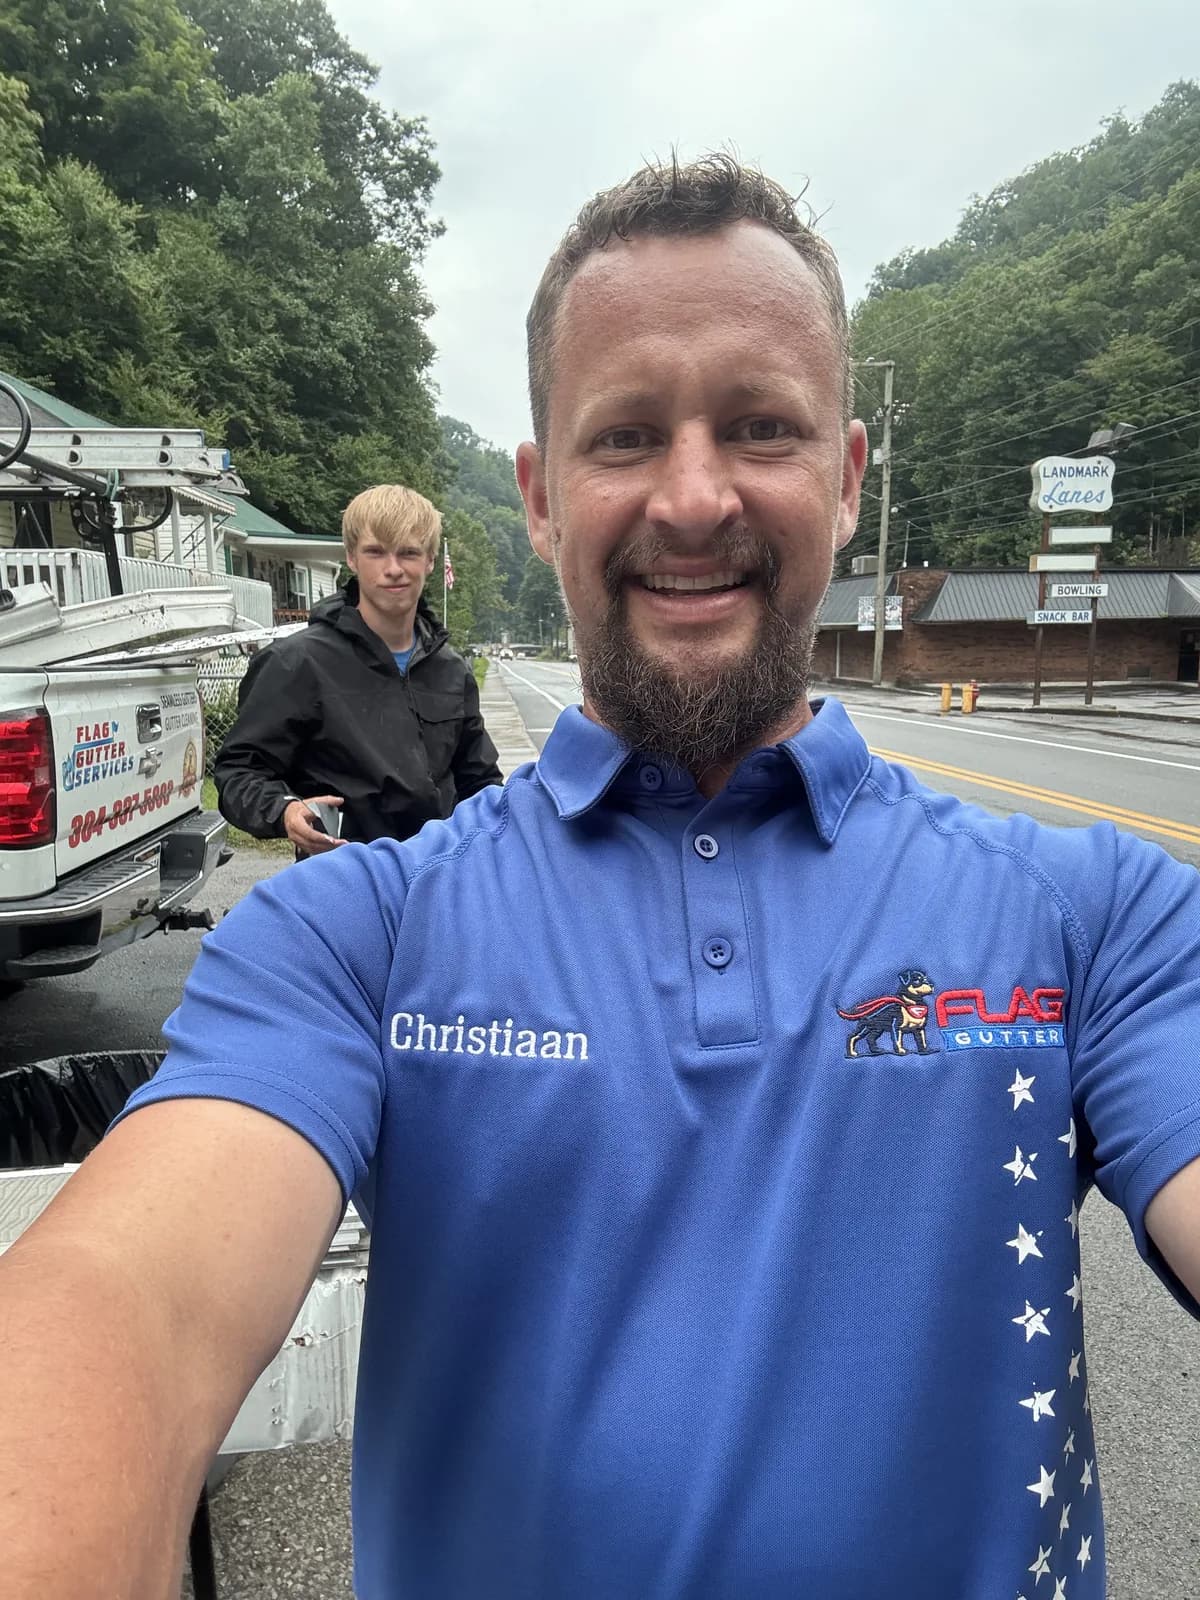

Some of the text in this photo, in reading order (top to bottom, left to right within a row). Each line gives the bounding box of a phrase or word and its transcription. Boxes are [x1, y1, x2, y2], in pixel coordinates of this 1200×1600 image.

[1043, 465, 1109, 479] LANDMARK
[1043, 480, 1106, 506] Lanes
[1057, 585, 1102, 596] BOWLING
[1037, 611, 1090, 622] SNACK BAR
[76, 722, 110, 743] FLAG
[76, 742, 126, 768] GUTTER
[74, 756, 134, 787] SERVICES
[936, 986, 1064, 1026] FLAG
[389, 1011, 590, 1062] Christiaan
[955, 1029, 1060, 1046] GUTTER
